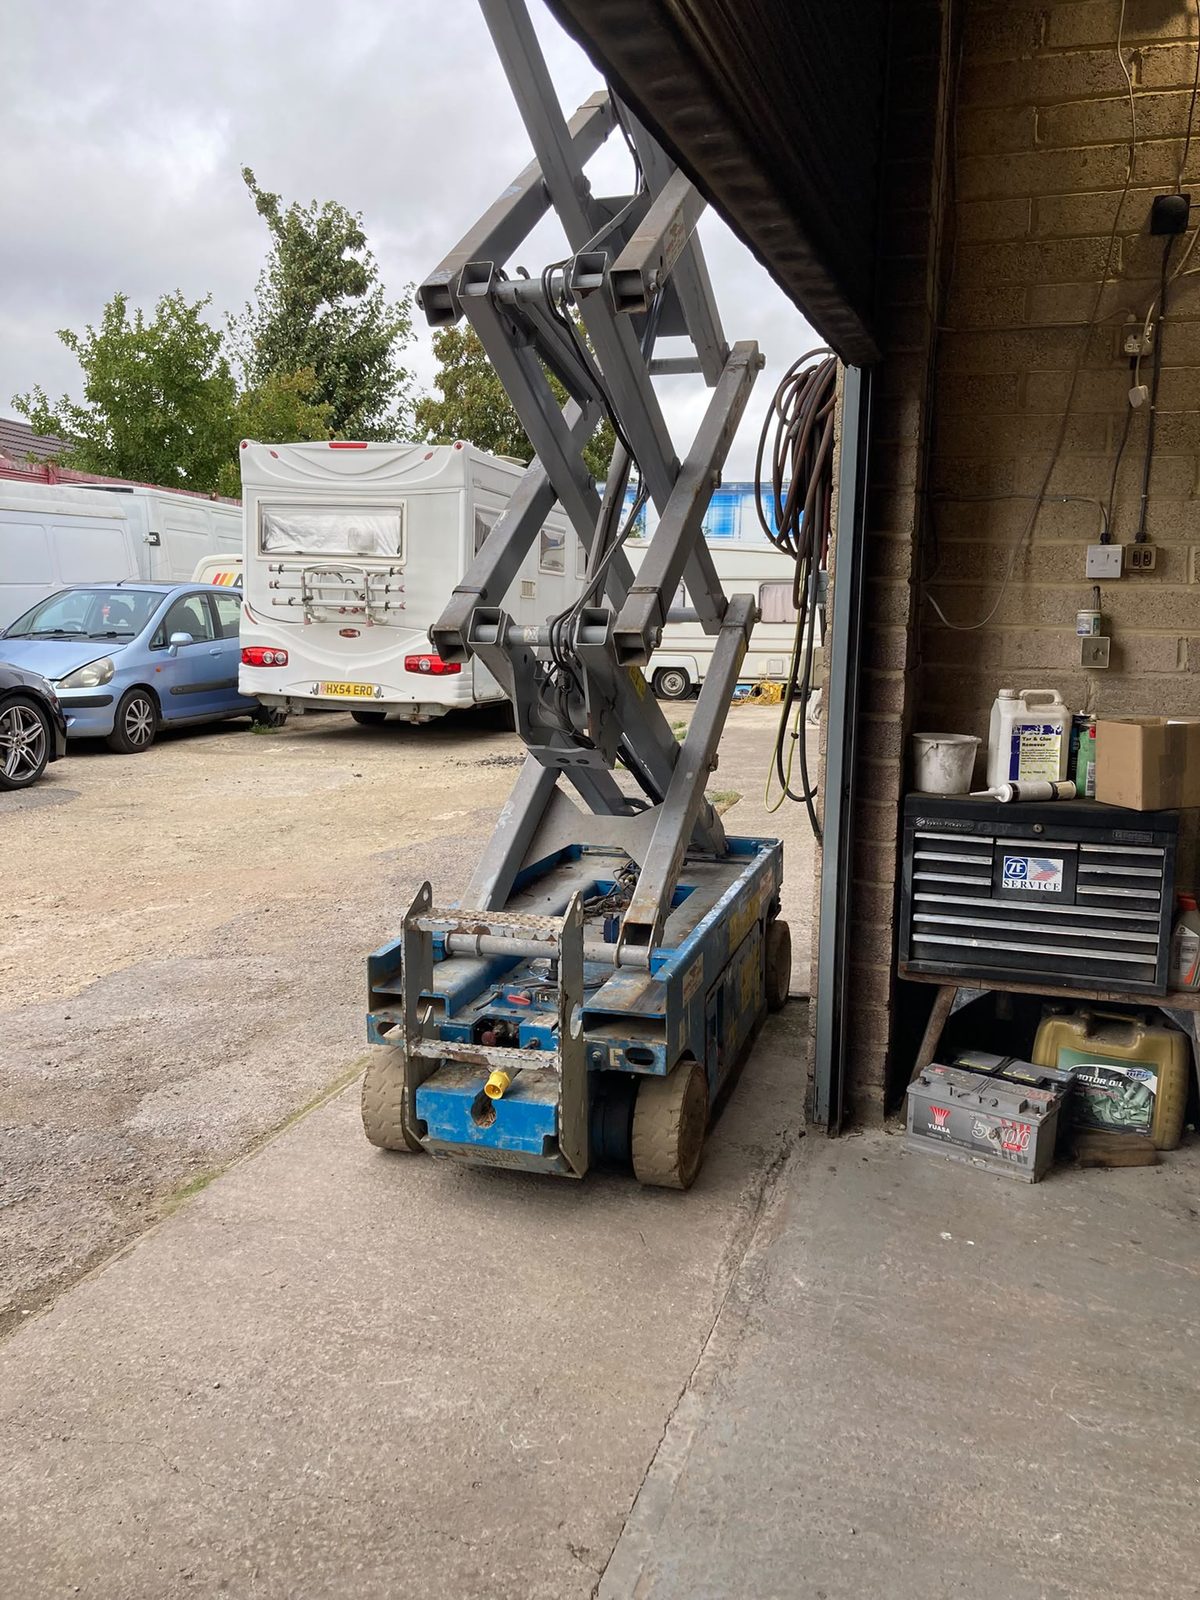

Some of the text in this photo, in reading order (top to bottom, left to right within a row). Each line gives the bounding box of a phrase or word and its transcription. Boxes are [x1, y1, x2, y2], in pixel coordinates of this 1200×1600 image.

[326, 683, 373, 696] HX54 ERO
[1008, 862, 1025, 875] ZF
[1003, 879, 1061, 891] SERVICE
[1076, 1073, 1107, 1085] MOTOR
[1108, 1079, 1124, 1088] OIL
[927, 1122, 951, 1134] YUASA
